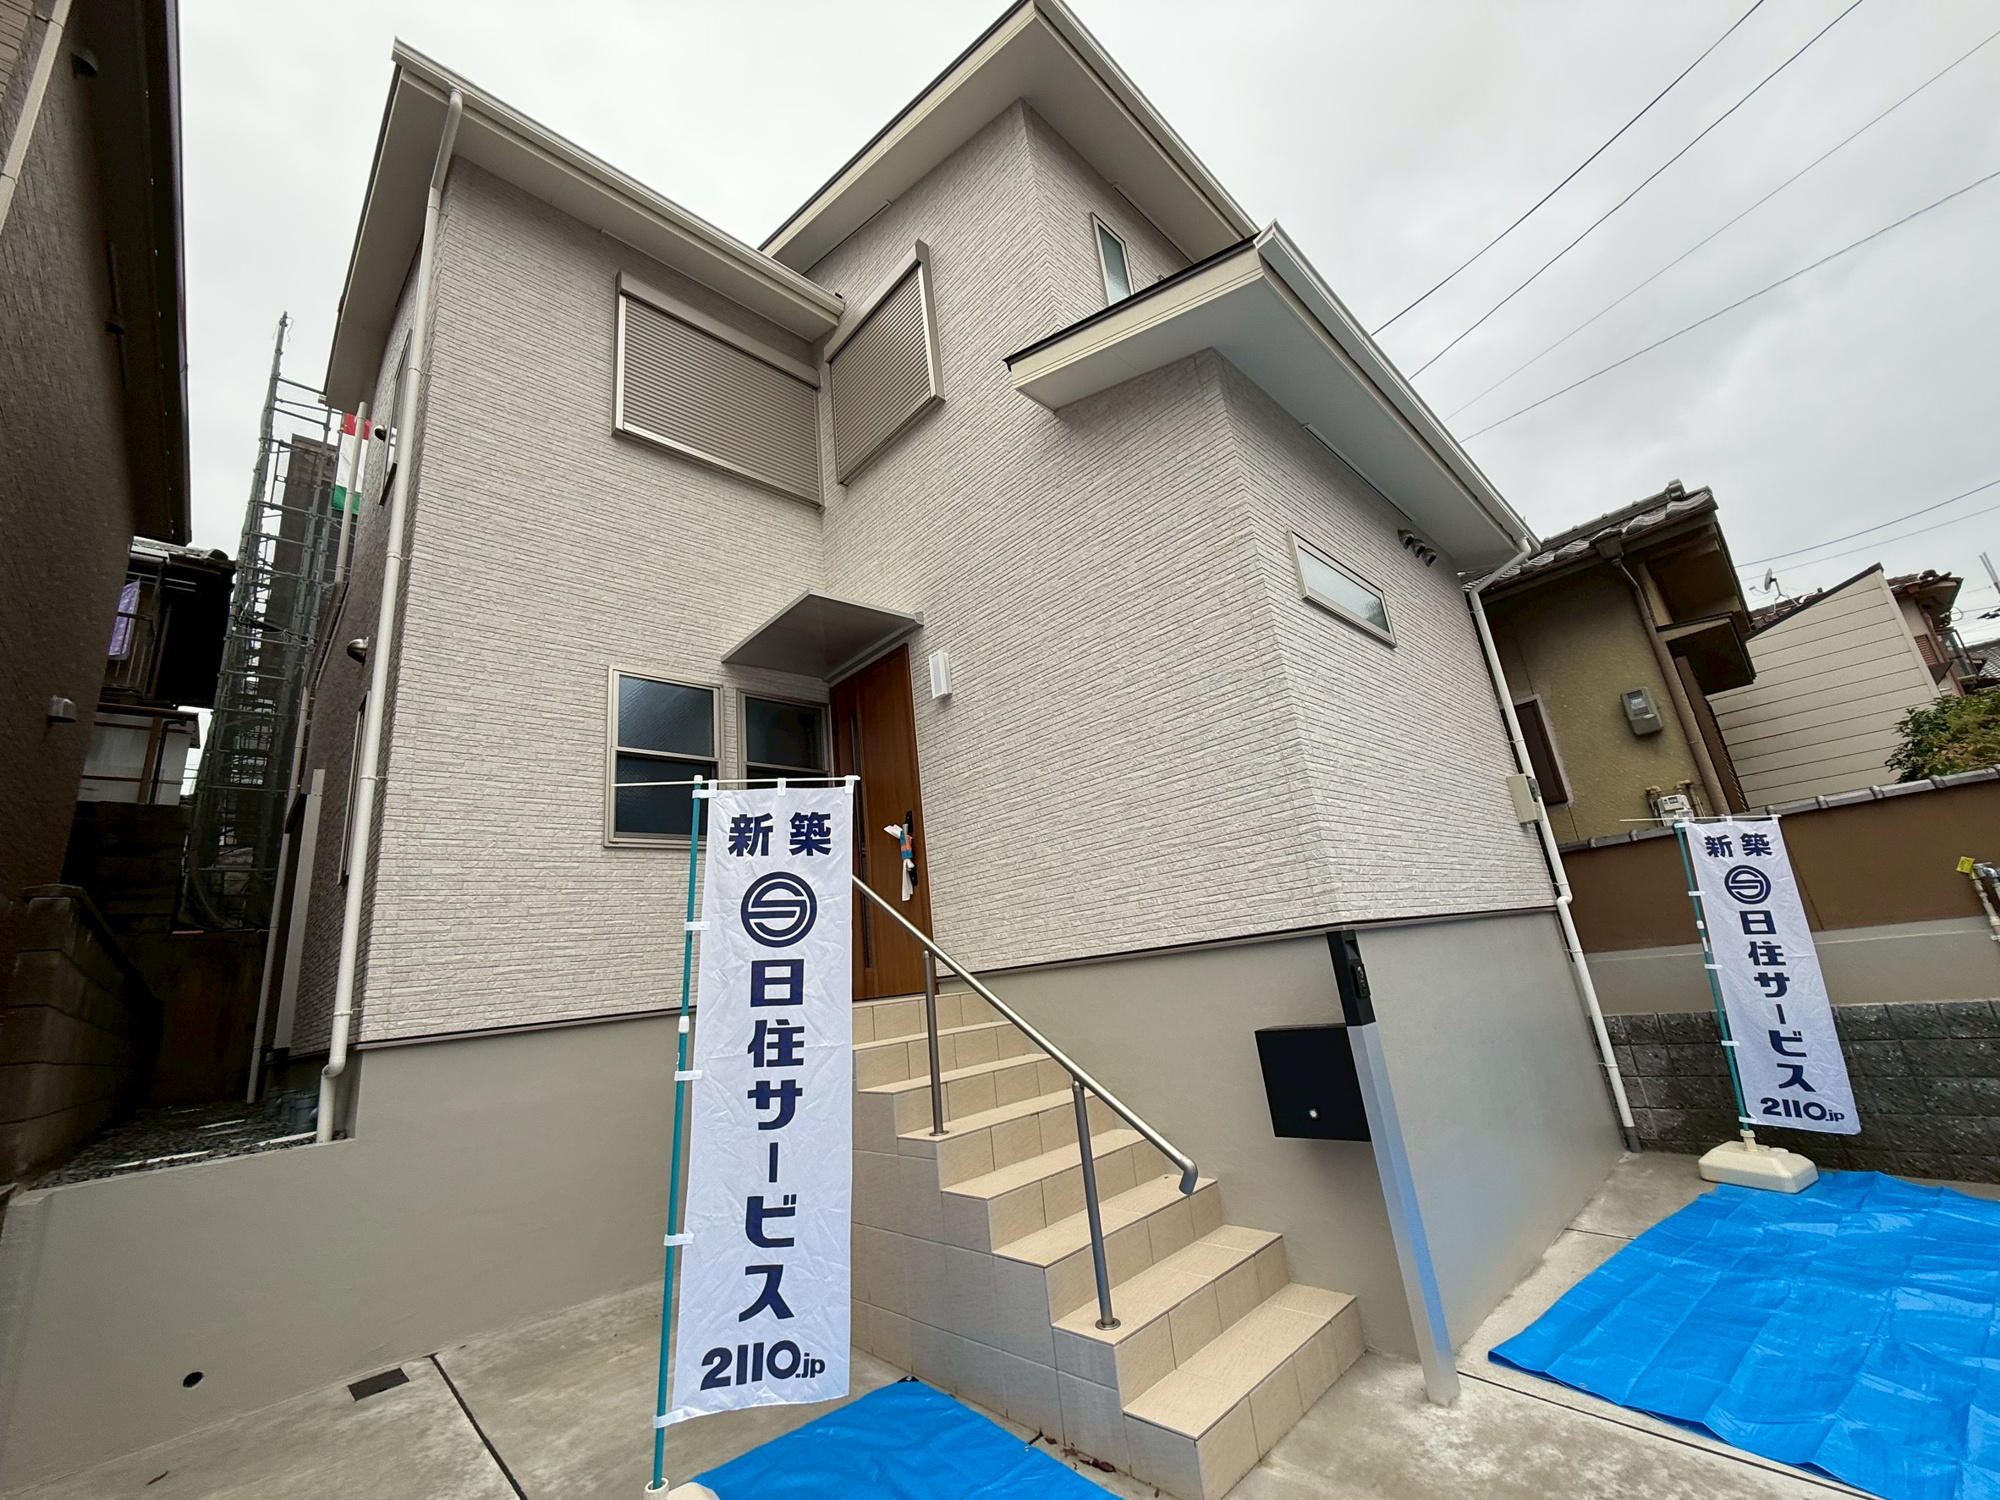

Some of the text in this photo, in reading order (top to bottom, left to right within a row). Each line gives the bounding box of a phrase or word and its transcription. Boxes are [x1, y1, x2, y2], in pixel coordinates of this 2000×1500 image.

[727, 811, 832, 857] 新築
[1704, 832, 1773, 858] 新築
[1738, 909, 1817, 1093] 日住サービス
[1759, 1096, 1845, 1123] 2110.jp
[737, 958, 805, 1323] 日住サービス
[699, 1339, 826, 1391] 2110.jp
